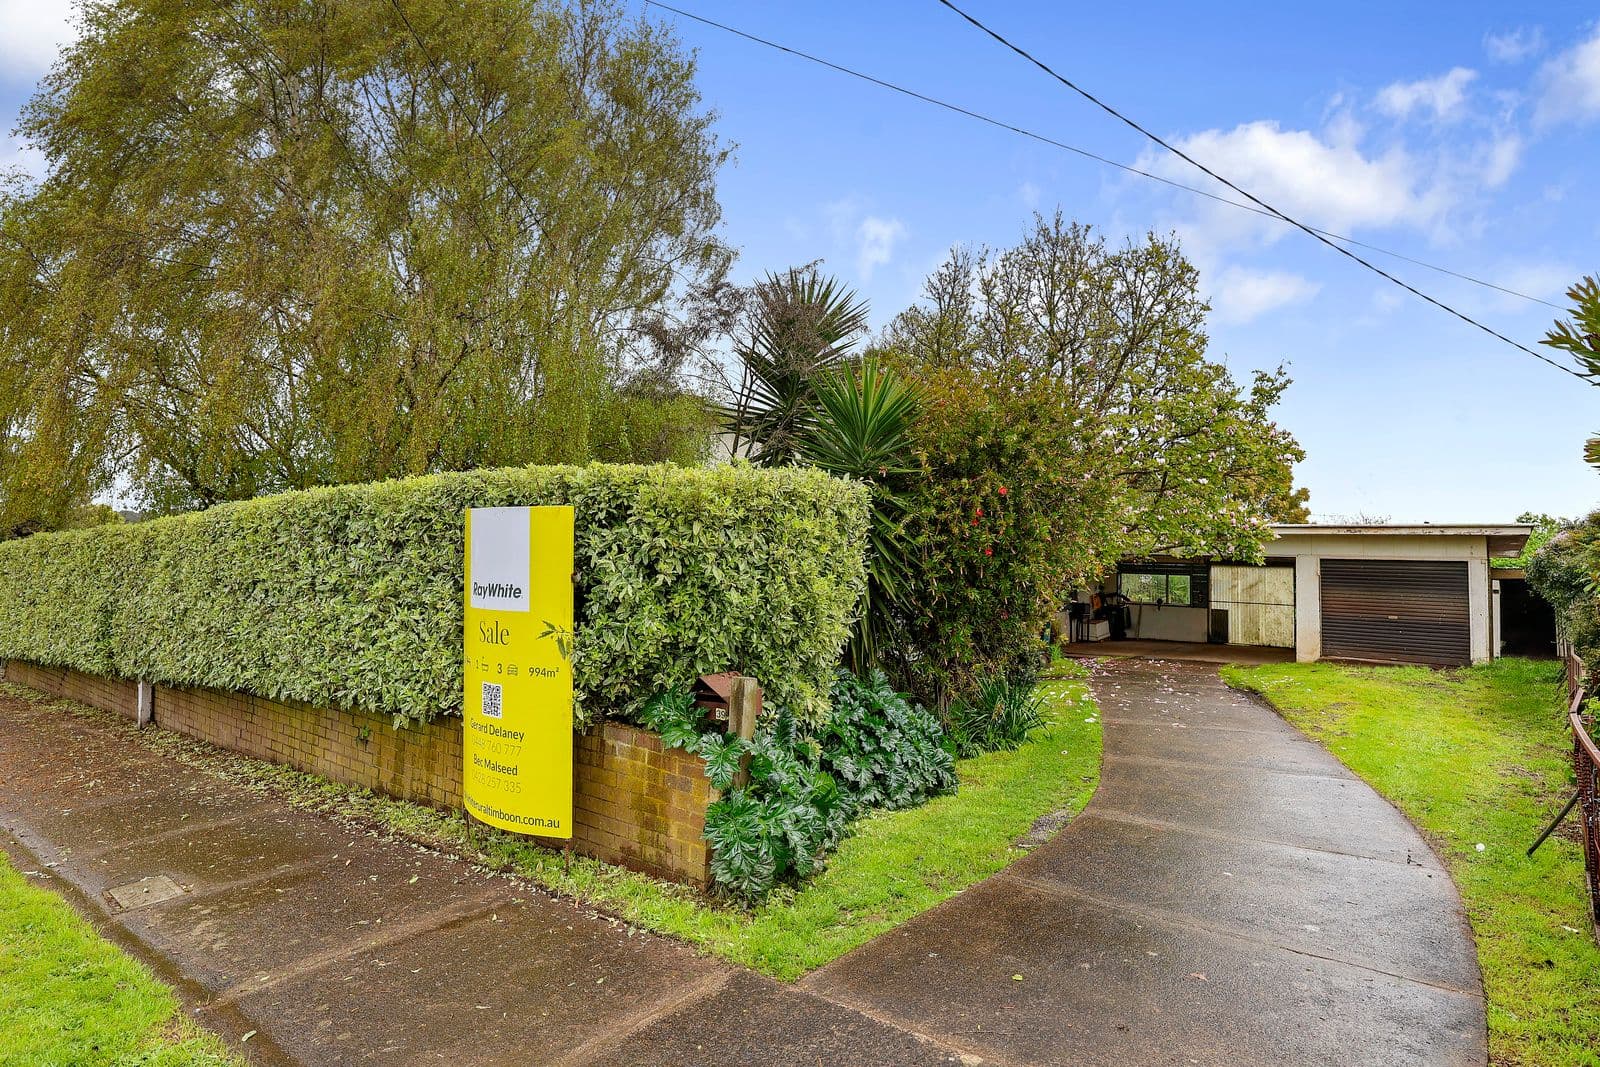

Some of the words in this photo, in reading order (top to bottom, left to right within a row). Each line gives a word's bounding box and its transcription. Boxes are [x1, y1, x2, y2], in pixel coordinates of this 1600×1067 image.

[473, 582, 522, 599] RayWhite
[479, 620, 510, 646] Sale
[496, 663, 503, 674] 3
[489, 724, 525, 742] Delaney
[504, 743, 522, 757] 777
[484, 758, 518, 776] Malseed
